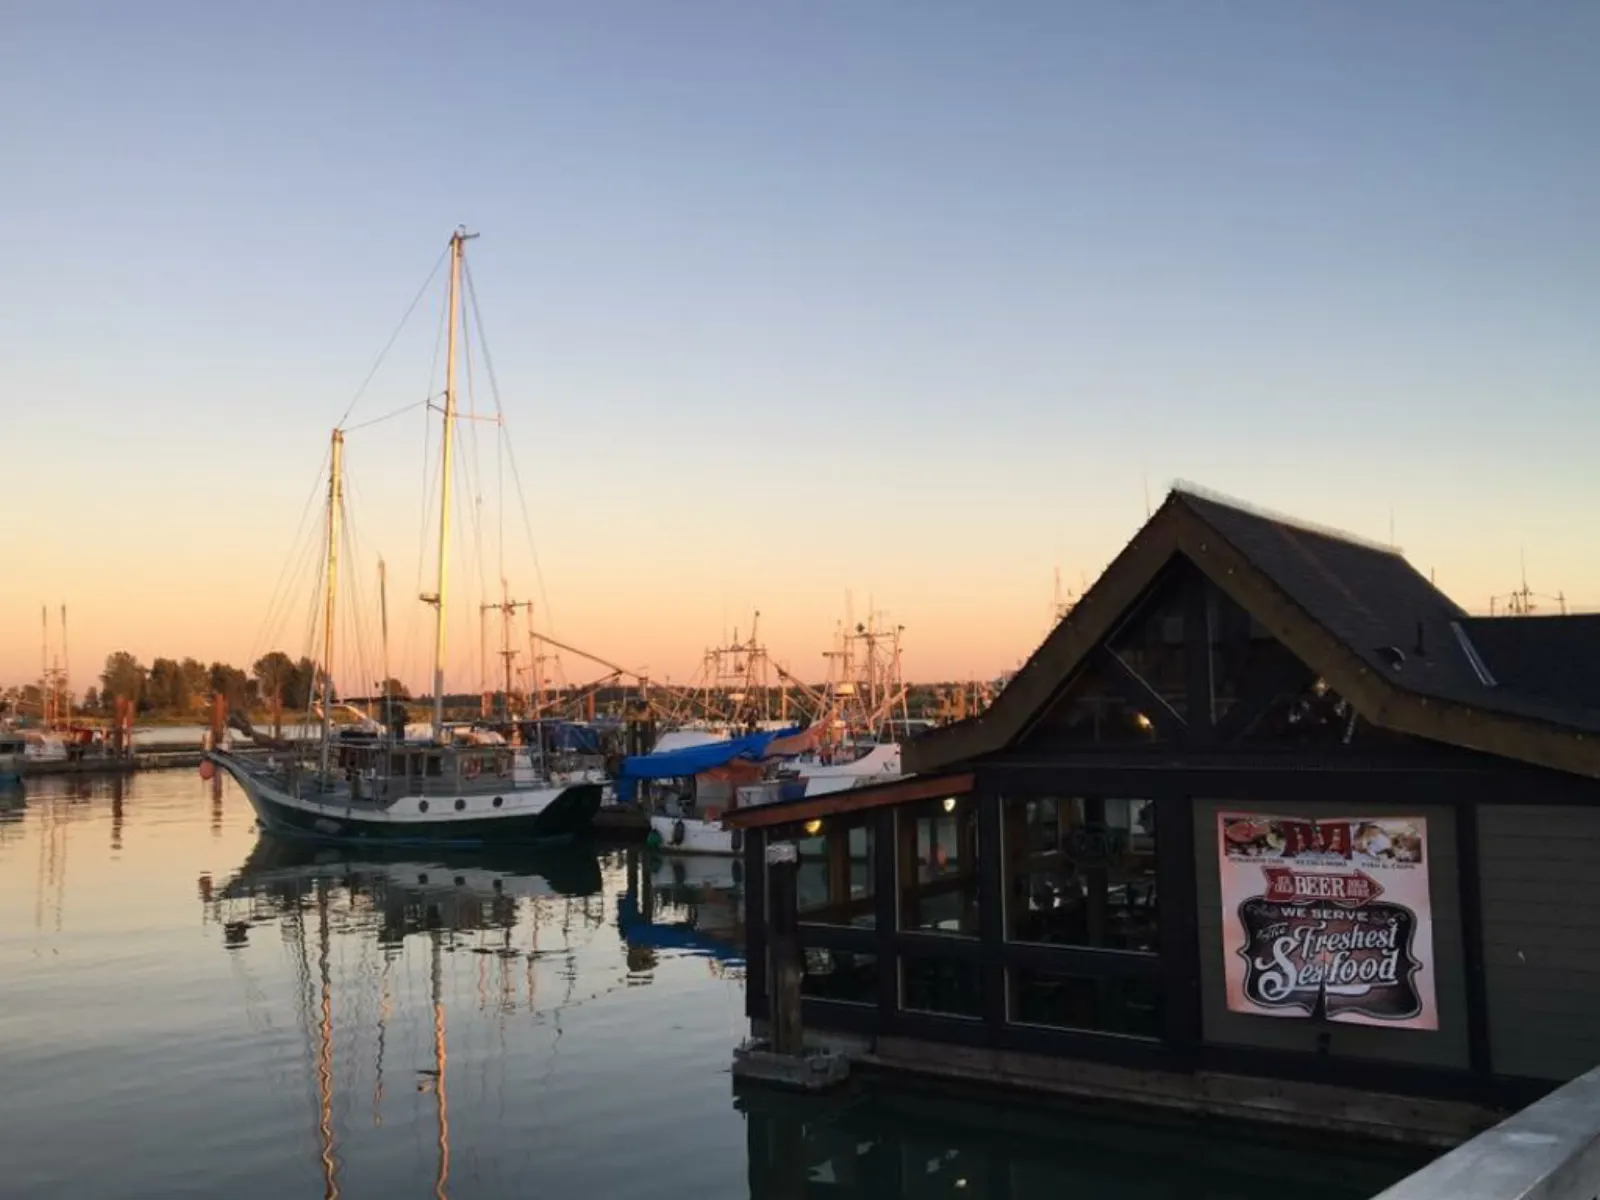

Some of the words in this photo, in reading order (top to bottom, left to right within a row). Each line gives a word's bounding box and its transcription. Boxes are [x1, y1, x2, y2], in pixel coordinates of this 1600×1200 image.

[1295, 876, 1346, 897] BEER
[1281, 907, 1306, 918] WE
[1312, 909, 1369, 921] SERVE
[1294, 918, 1399, 959] Freshest
[1255, 936, 1400, 1000] Seafood
